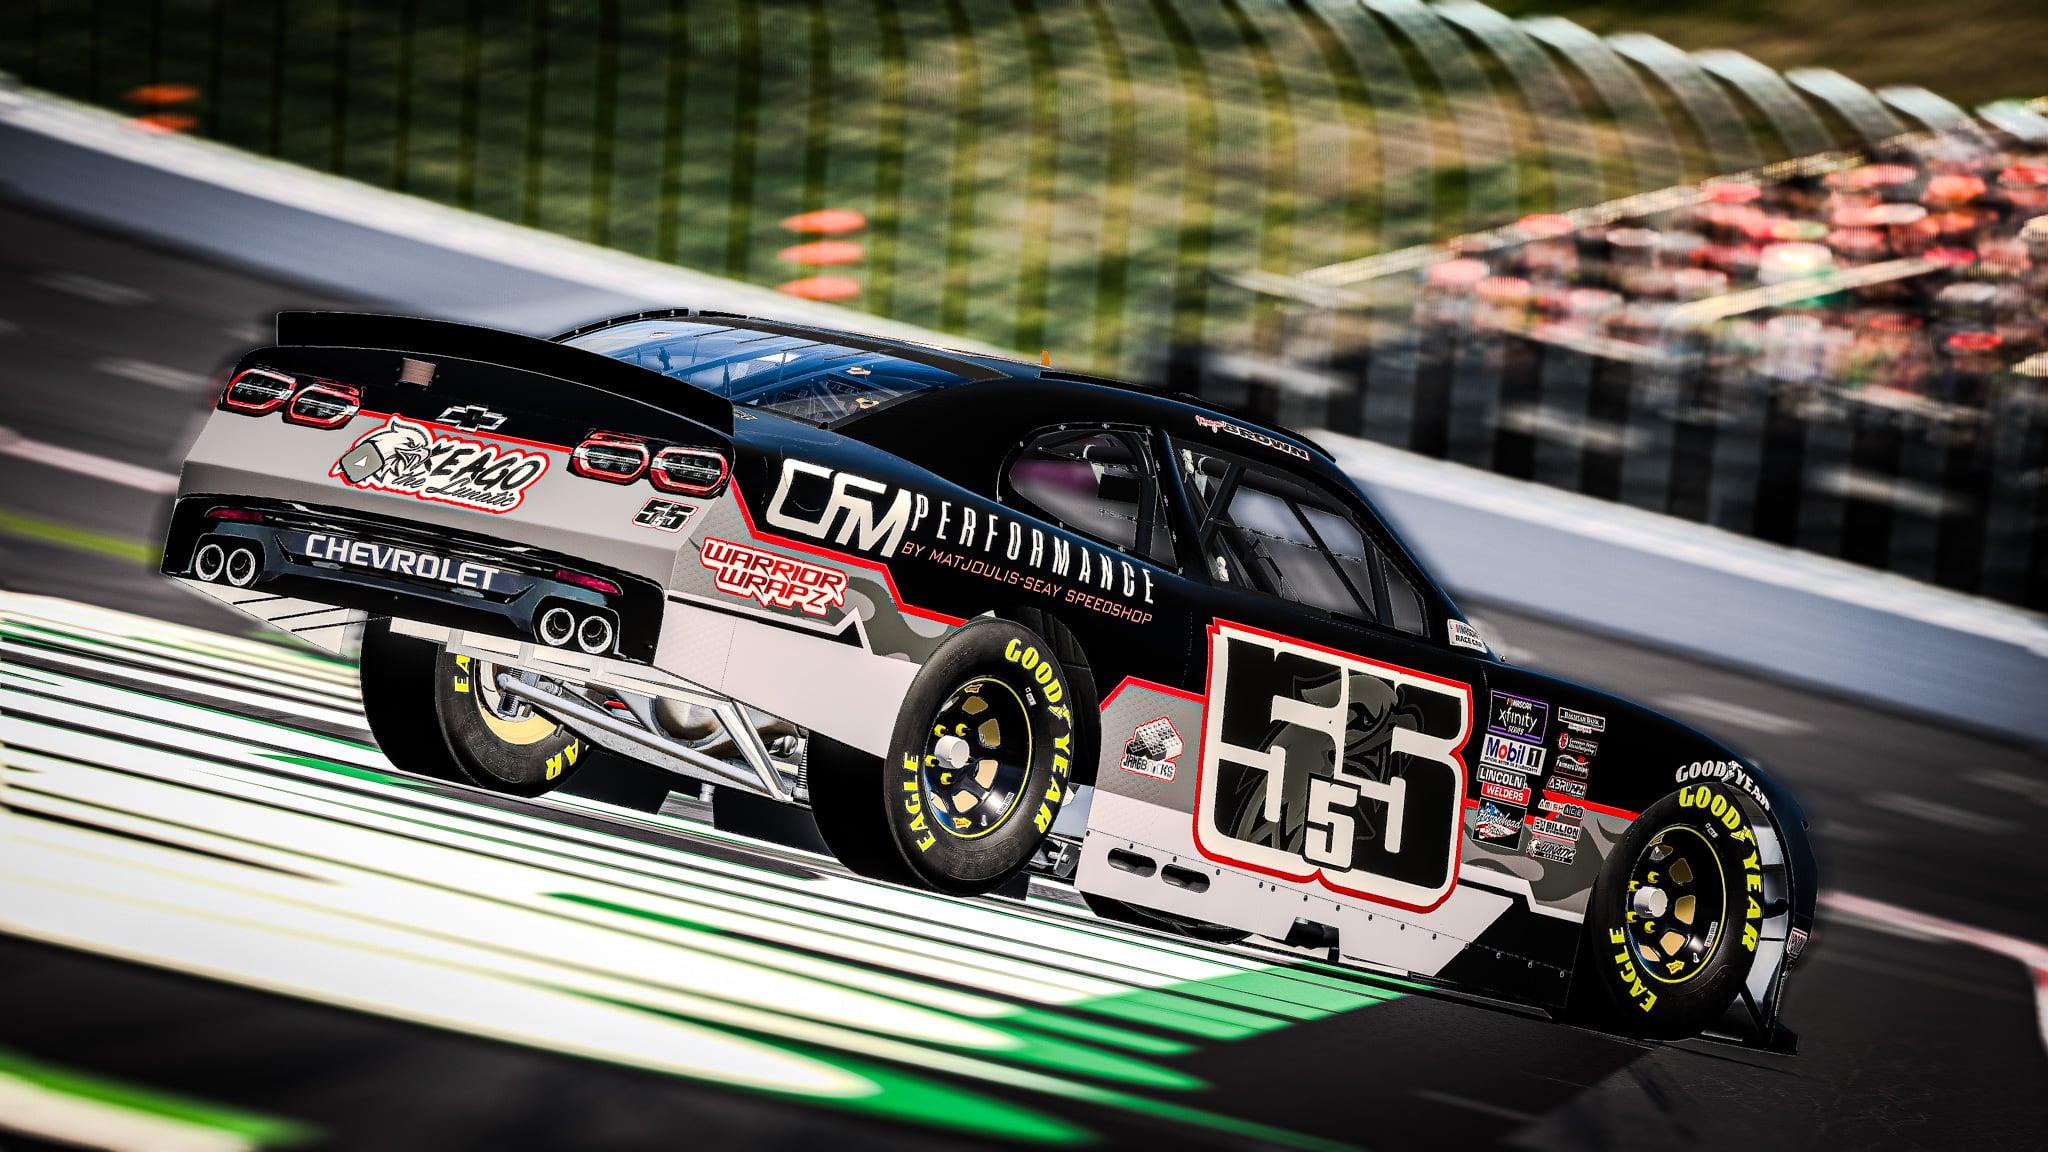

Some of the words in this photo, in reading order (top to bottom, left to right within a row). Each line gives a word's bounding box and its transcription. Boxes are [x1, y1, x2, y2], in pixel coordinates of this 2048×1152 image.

[1222, 423, 1310, 462] BROWN
[391, 469, 427, 489] the
[424, 477, 516, 508] Lunatic
[305, 533, 500, 590] CHEVROLET
[703, 543, 844, 596] WARRIOR
[909, 493, 1155, 604] PERFORMANCE
[717, 566, 829, 609] WRAPZ
[901, 541, 925, 556] BY
[932, 549, 1062, 594] MATJOULIS-SEAY
[1065, 589, 1154, 625] SPEEDSHOP
[1004, 638, 1075, 834] GOODYEAR
[1498, 706, 1538, 734] xfinity
[1507, 725, 1525, 736] SERIES
[1209, 636, 1462, 892] 55
[1479, 767, 1522, 789] LINCOLN
[1485, 737, 1526, 767] Mobil
[903, 752, 937, 852] EAGLE
[1487, 784, 1524, 802] WELDERS
[1675, 760, 1771, 812] GOODYEAR
[1304, 778, 1359, 868] 5
[1546, 822, 1579, 838] BILLION
[1678, 785, 1761, 953] GOODYEAR
[1608, 926, 1658, 1013] EAGLE
